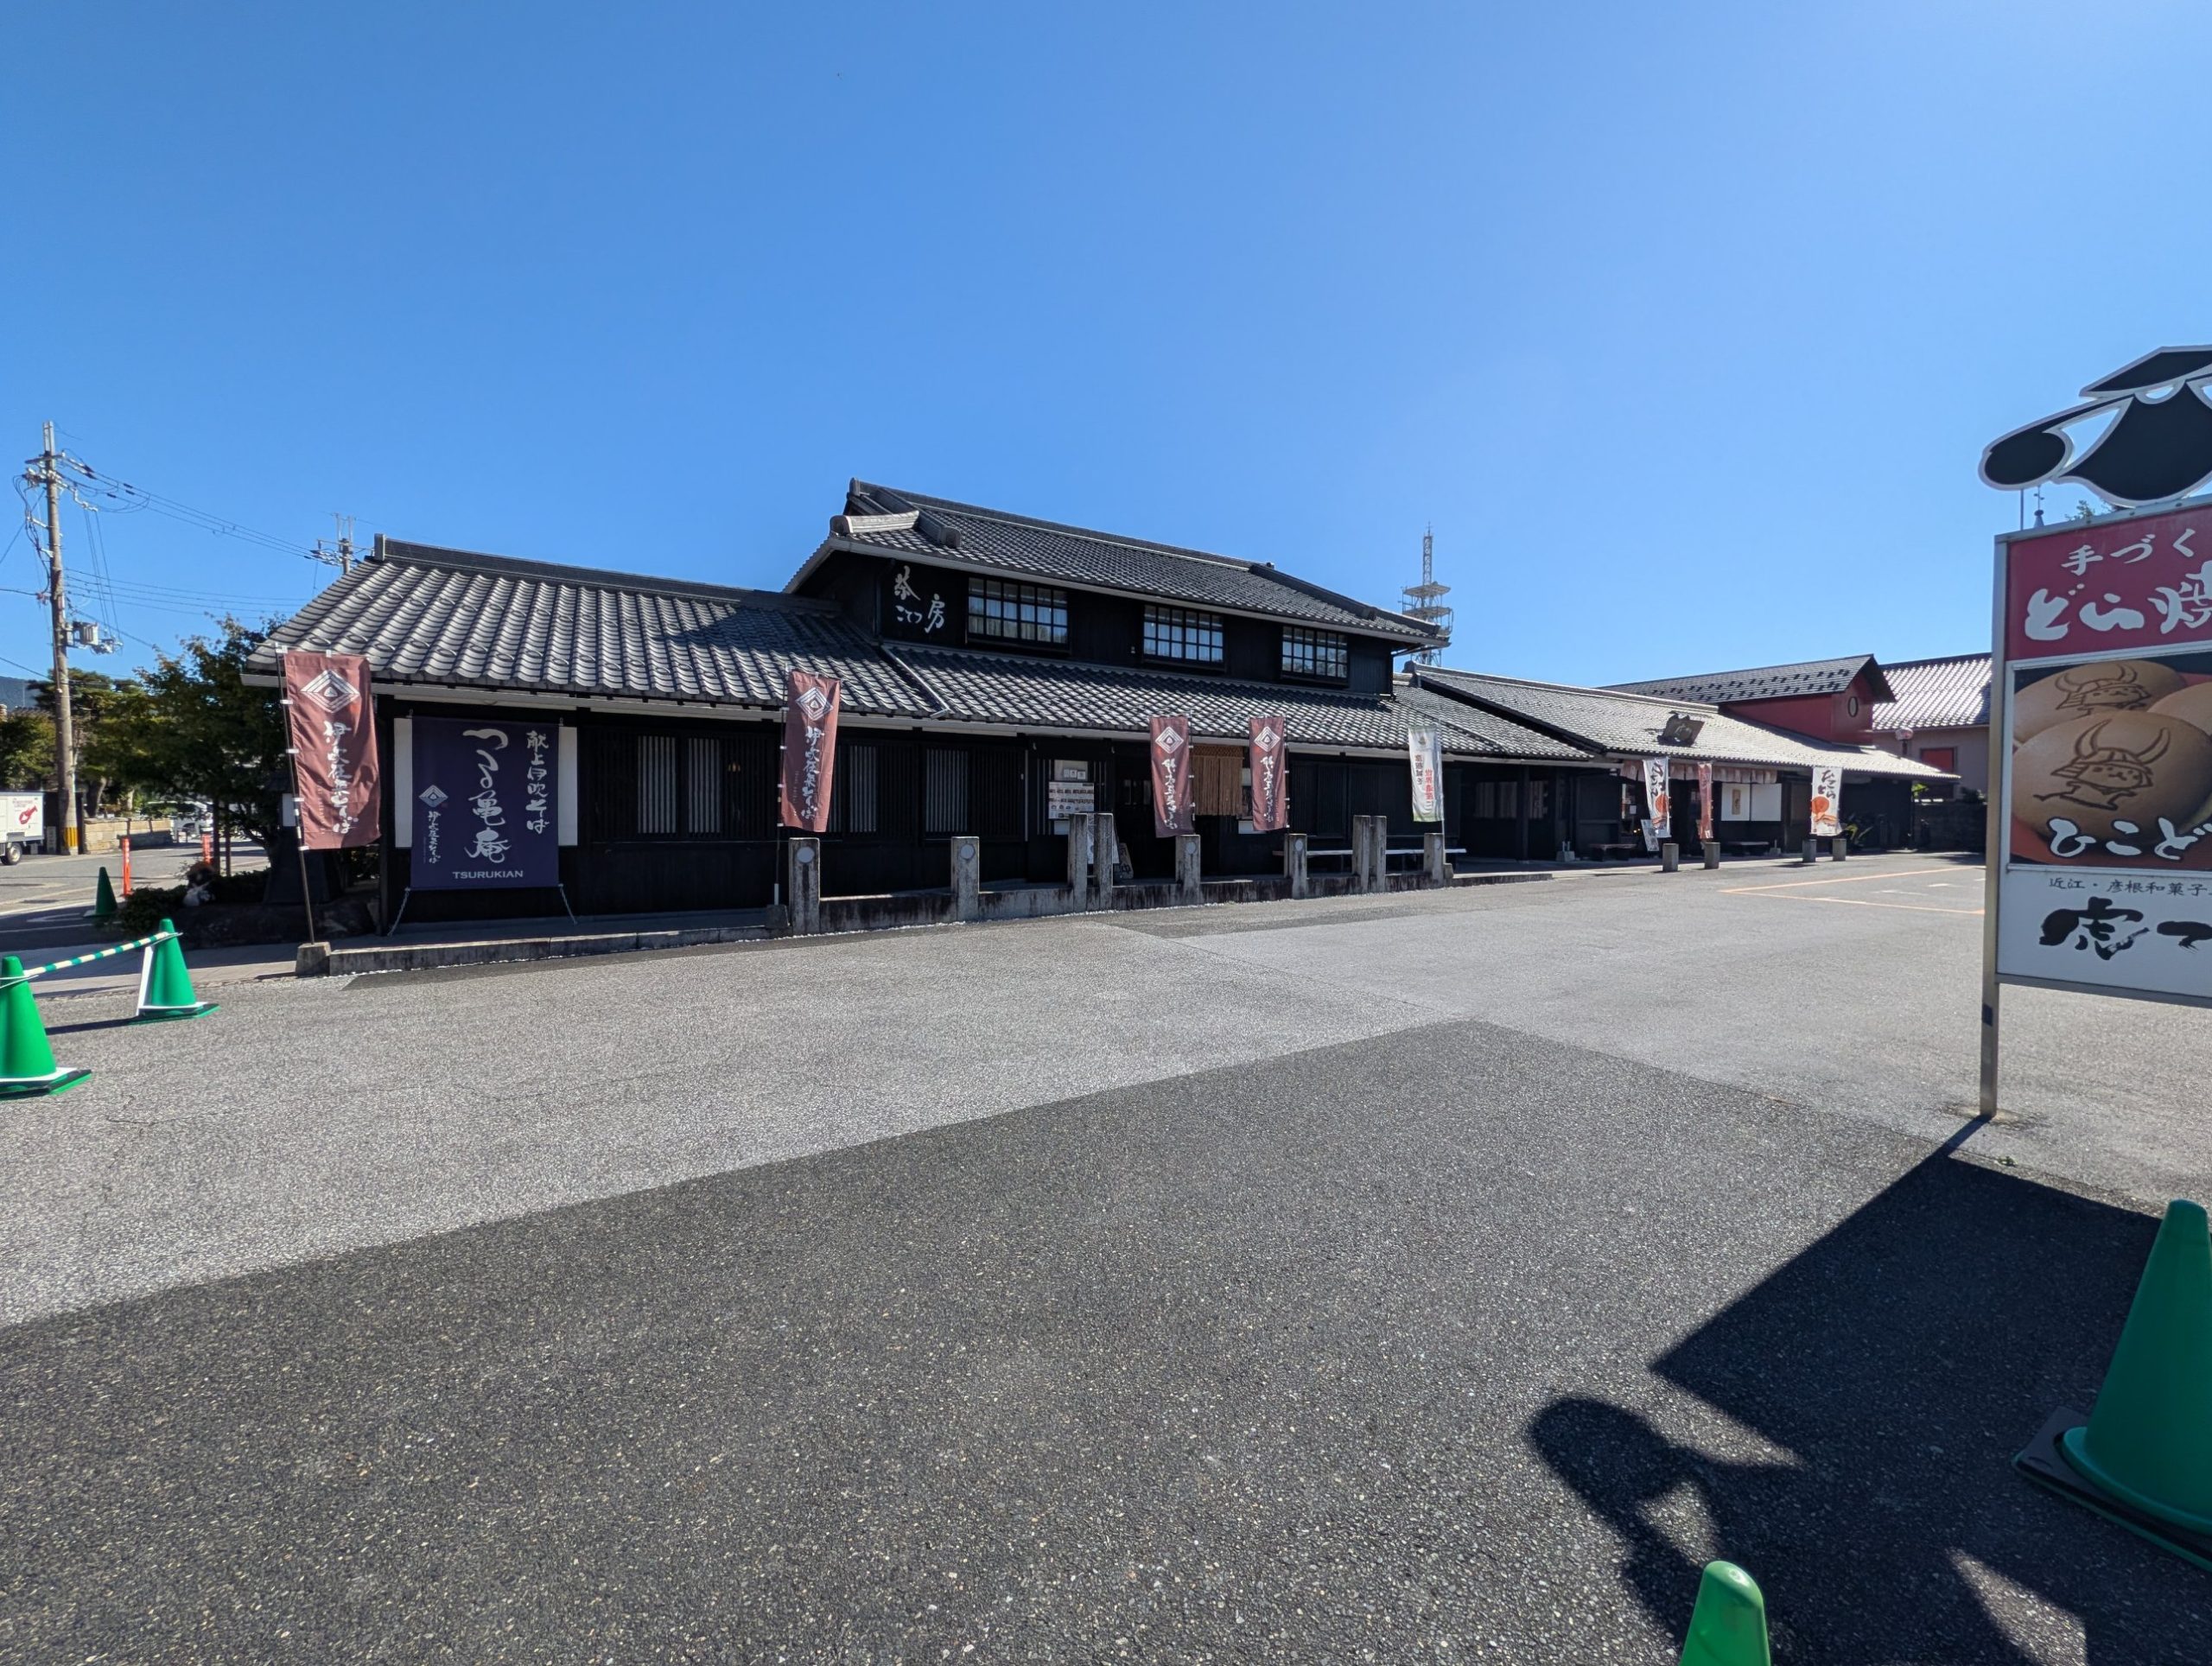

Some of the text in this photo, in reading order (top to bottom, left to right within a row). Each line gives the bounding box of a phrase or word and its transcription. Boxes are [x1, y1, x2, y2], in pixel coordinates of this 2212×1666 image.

[2061, 528, 2196, 575] 手づく
[452, 870, 524, 880] TSURUKIAN
[2049, 877, 2212, 896] 近江・彦根和菓子
